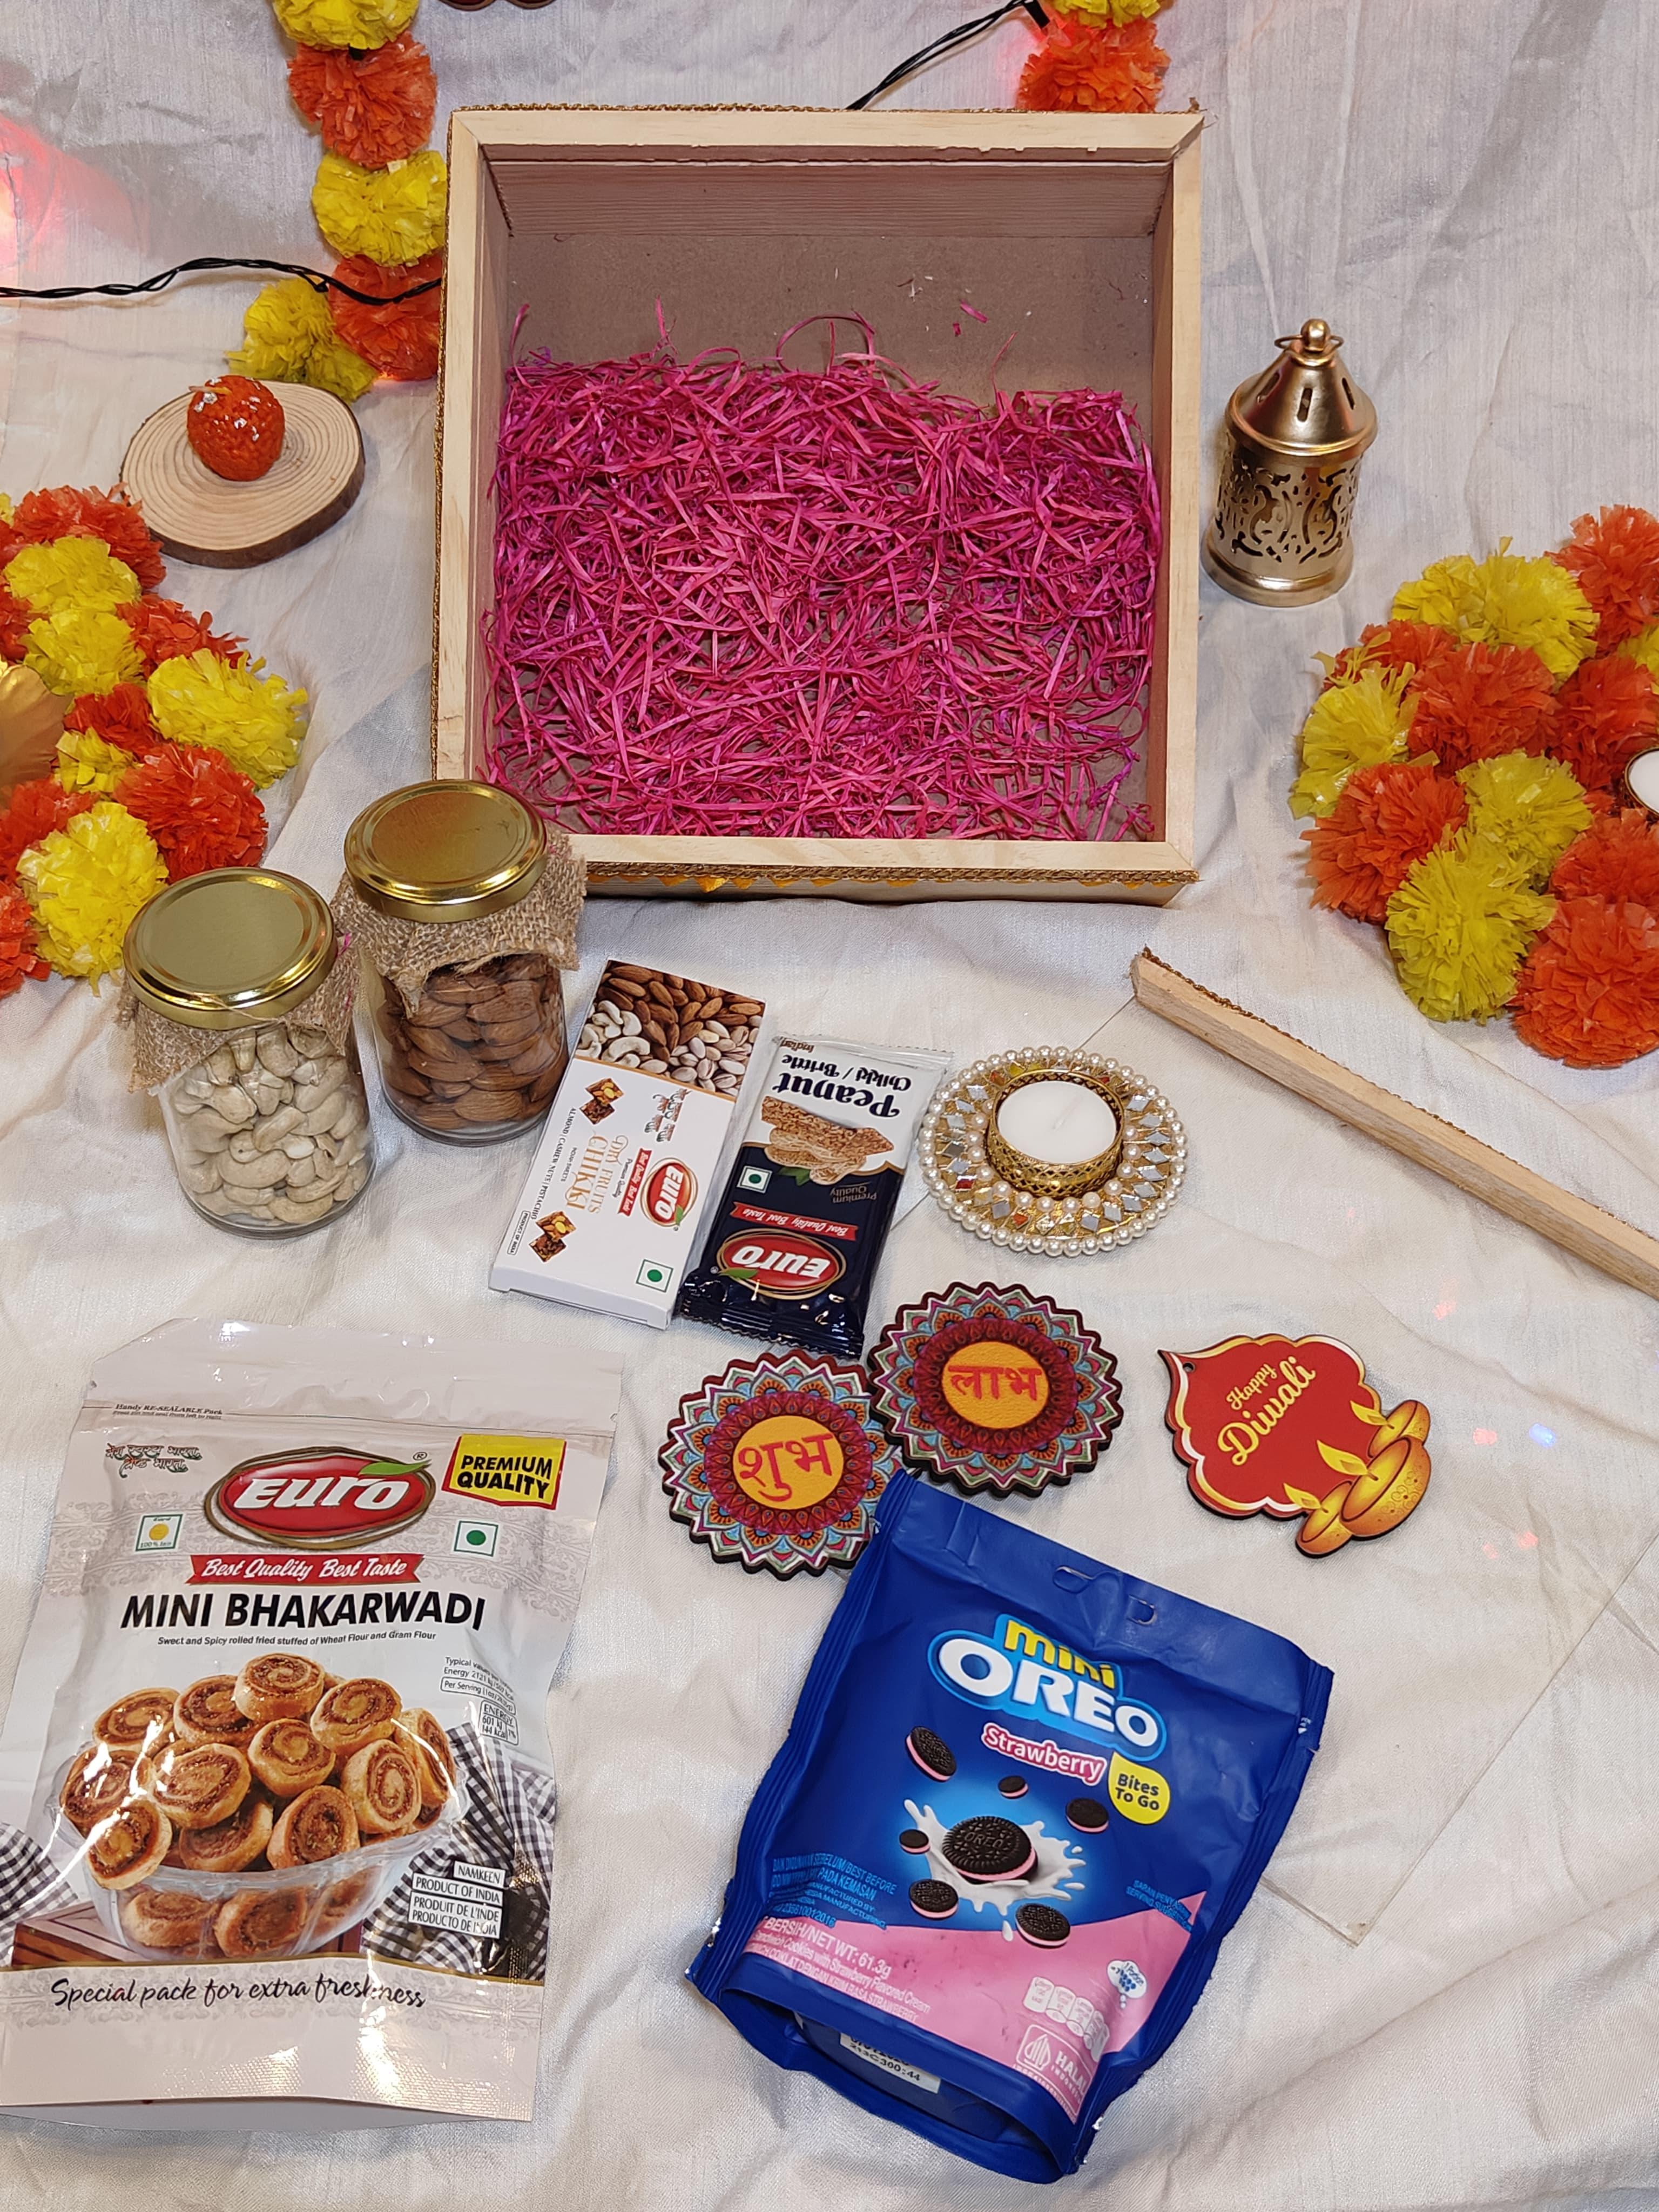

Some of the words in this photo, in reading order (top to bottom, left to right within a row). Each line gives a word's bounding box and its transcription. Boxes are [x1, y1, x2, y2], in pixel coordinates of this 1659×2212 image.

[782, 1055, 839, 1077] Brittle
[855, 1068, 911, 1091] Chikki
[772, 1073, 900, 1117] Peanut
[562, 1108, 577, 1135] ALMOND
[552, 1137, 566, 1164] CASHEW
[605, 1135, 629, 1165] DRY
[545, 1164, 556, 1183] NUTS
[565, 1136, 609, 1210] CHIKKI
[588, 1168, 613, 1214] FRUITS
[830, 1186, 867, 1197] Quality
[833, 1192, 877, 1203] Premium
[743, 1209, 766, 1221] Taste
[766, 1215, 788, 1225] Best
[792, 1217, 826, 1231] Quality
[826, 1225, 848, 1236] Best
[948, 1365, 1042, 1401] लाभ
[1226, 1363, 1278, 1411] Happy
[1217, 1356, 1316, 1466] Diwali
[461, 1455, 552, 1480] PREMIUM
[738, 1434, 834, 1502] शुभ
[457, 1471, 550, 1499] QUALITY
[201, 1559, 241, 1577] Best
[243, 1559, 314, 1581] Quality
[319, 1559, 360, 1577] Best
[362, 1558, 407, 1576] Taste
[120, 1593, 214, 1628] MINI
[225, 1591, 485, 1631] BHAKARWADI
[185, 1637, 202, 1645] and
[204, 1637, 227, 1646] Spicy
[229, 1636, 253, 1644] rolled
[255, 1636, 275, 1644] fried
[277, 1636, 308, 1645] stuffed
[310, 1636, 321, 1644] of
[321, 1635, 346, 1644] Wheat
[348, 1634, 369, 1642] Flour
[370, 1631, 386, 1640] and
[389, 1630, 412, 1640] Gram
[414, 1630, 436, 1641] Flour
[446, 1657, 471, 1666] Typical
[1004, 1620, 1115, 1689] mini
[444, 1667, 469, 1677] Energy
[939, 1638, 1158, 1747] OREO
[482, 1716, 494, 1726] 601
[482, 1725, 492, 1734] 144
[985, 1727, 1104, 1782] Strawberry
[1117, 1773, 1159, 1796] Bites
[1115, 1787, 1135, 1803] To
[1137, 1796, 1159, 1811] Go
[964, 1831, 1004, 1849] OREO
[458, 1865, 501, 1884] NAMKEEN
[817, 1866, 838, 1884] PADA
[838, 1873, 877, 1901] KEMASAN
[865, 1873, 898, 1895] BEFORE
[416, 1877, 458, 1895] PRODUCT
[461, 1885, 473, 1897] OF
[476, 1887, 501, 1904] INDIA
[412, 1910, 458, 1928] PRODUCTO
[461, 1919, 471, 1932] DE
[414, 1896, 455, 1913] PRODUIT
[456, 1904, 468, 1917] DE
[470, 1907, 499, 1922] L'INDE
[783, 1937, 813, 1959] Cookies
[829, 1957, 872, 1988] Strawberry
[904, 1991, 931, 2014] Cream
[859, 1953, 892, 1980] 61.3g
[51, 1978, 136, 2011] Special
[138, 1977, 197, 2009] pack
[204, 1978, 244, 2007] for
[249, 1977, 312, 2001] extra
[1055, 2050, 1087, 2096] HALAL
